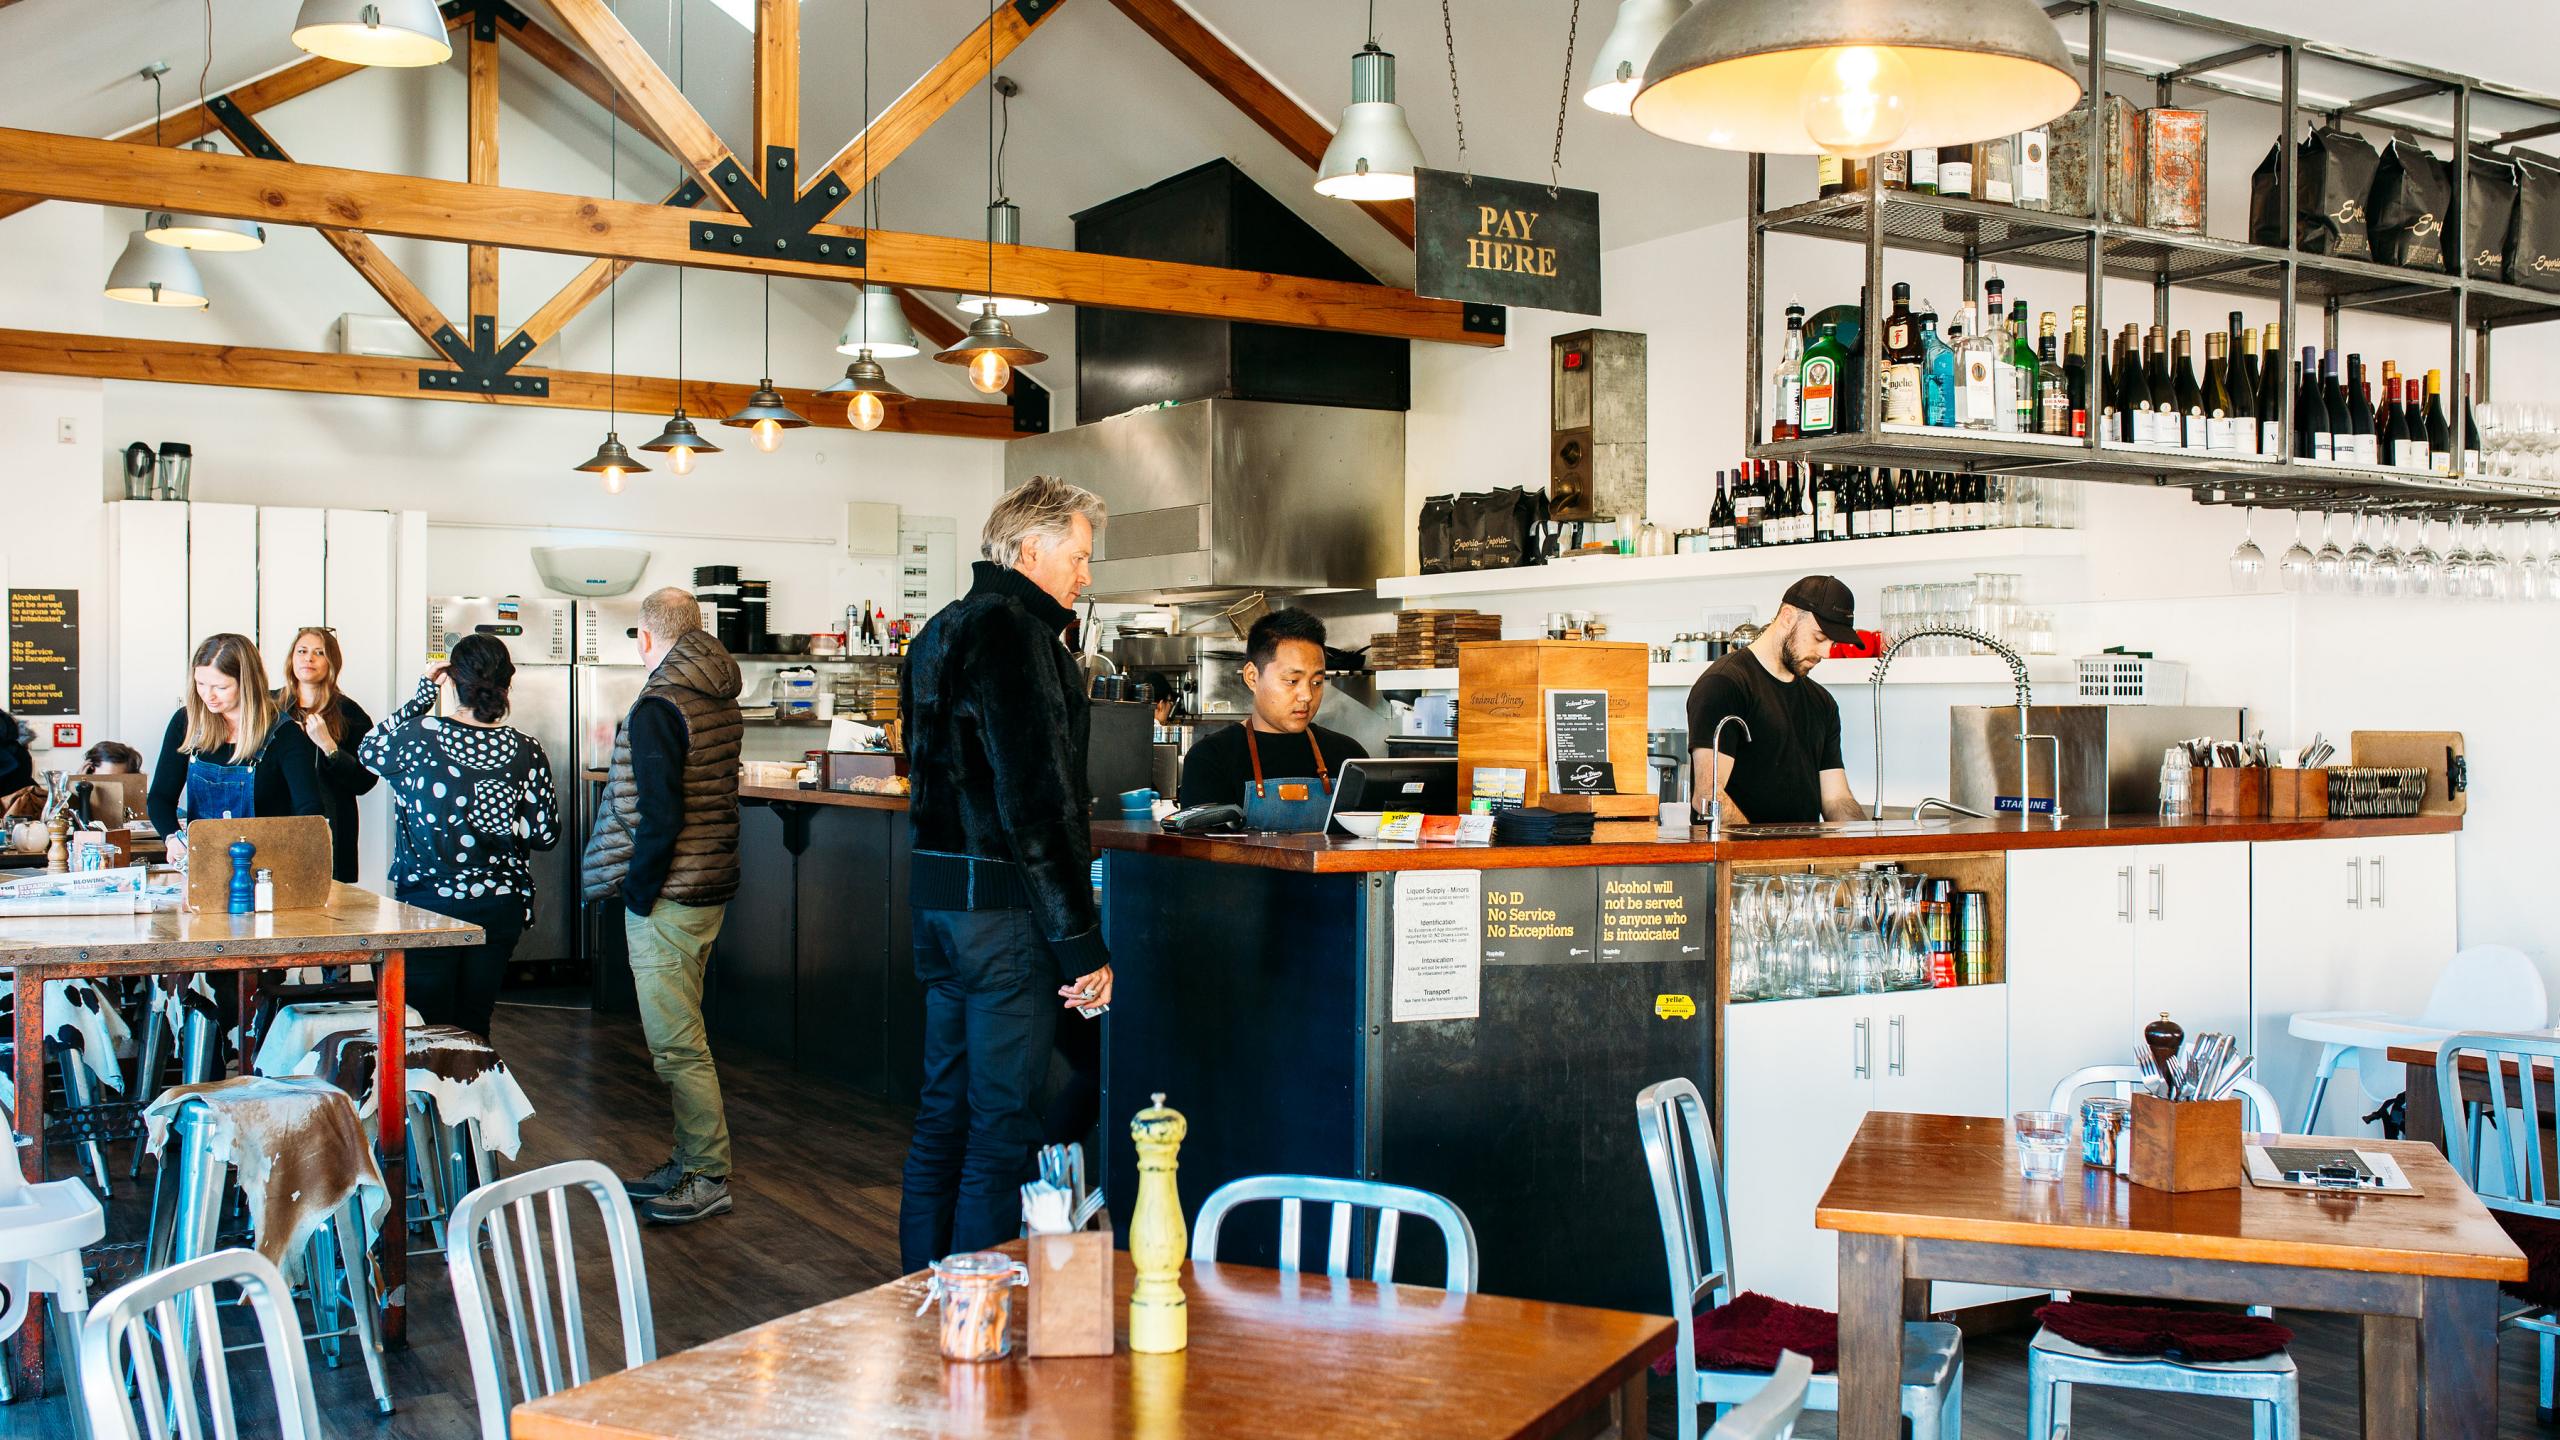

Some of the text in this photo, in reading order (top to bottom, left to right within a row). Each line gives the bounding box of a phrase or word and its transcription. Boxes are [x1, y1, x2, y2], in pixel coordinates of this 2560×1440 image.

[1478, 206, 1539, 241] PAY
[1466, 237, 1558, 278] HERE
[1453, 538, 1483, 552] Emporio
[1486, 536, 1511, 549] Emporio
[21, 609, 48, 617] anyone
[25, 655, 65, 663] Exceptions
[2000, 799, 2047, 810] STARINE
[73, 877, 106, 885] BLOWING
[1605, 880, 1673, 894] Alcohol will
[1487, 891, 1524, 905] No ID
[1604, 895, 1683, 910] not be served
[1487, 907, 1556, 921] No Service
[1604, 911, 1687, 928] to anyone who
[1487, 923, 1574, 940] No Exceptions
[1603, 927, 1680, 941] is intoxicated
